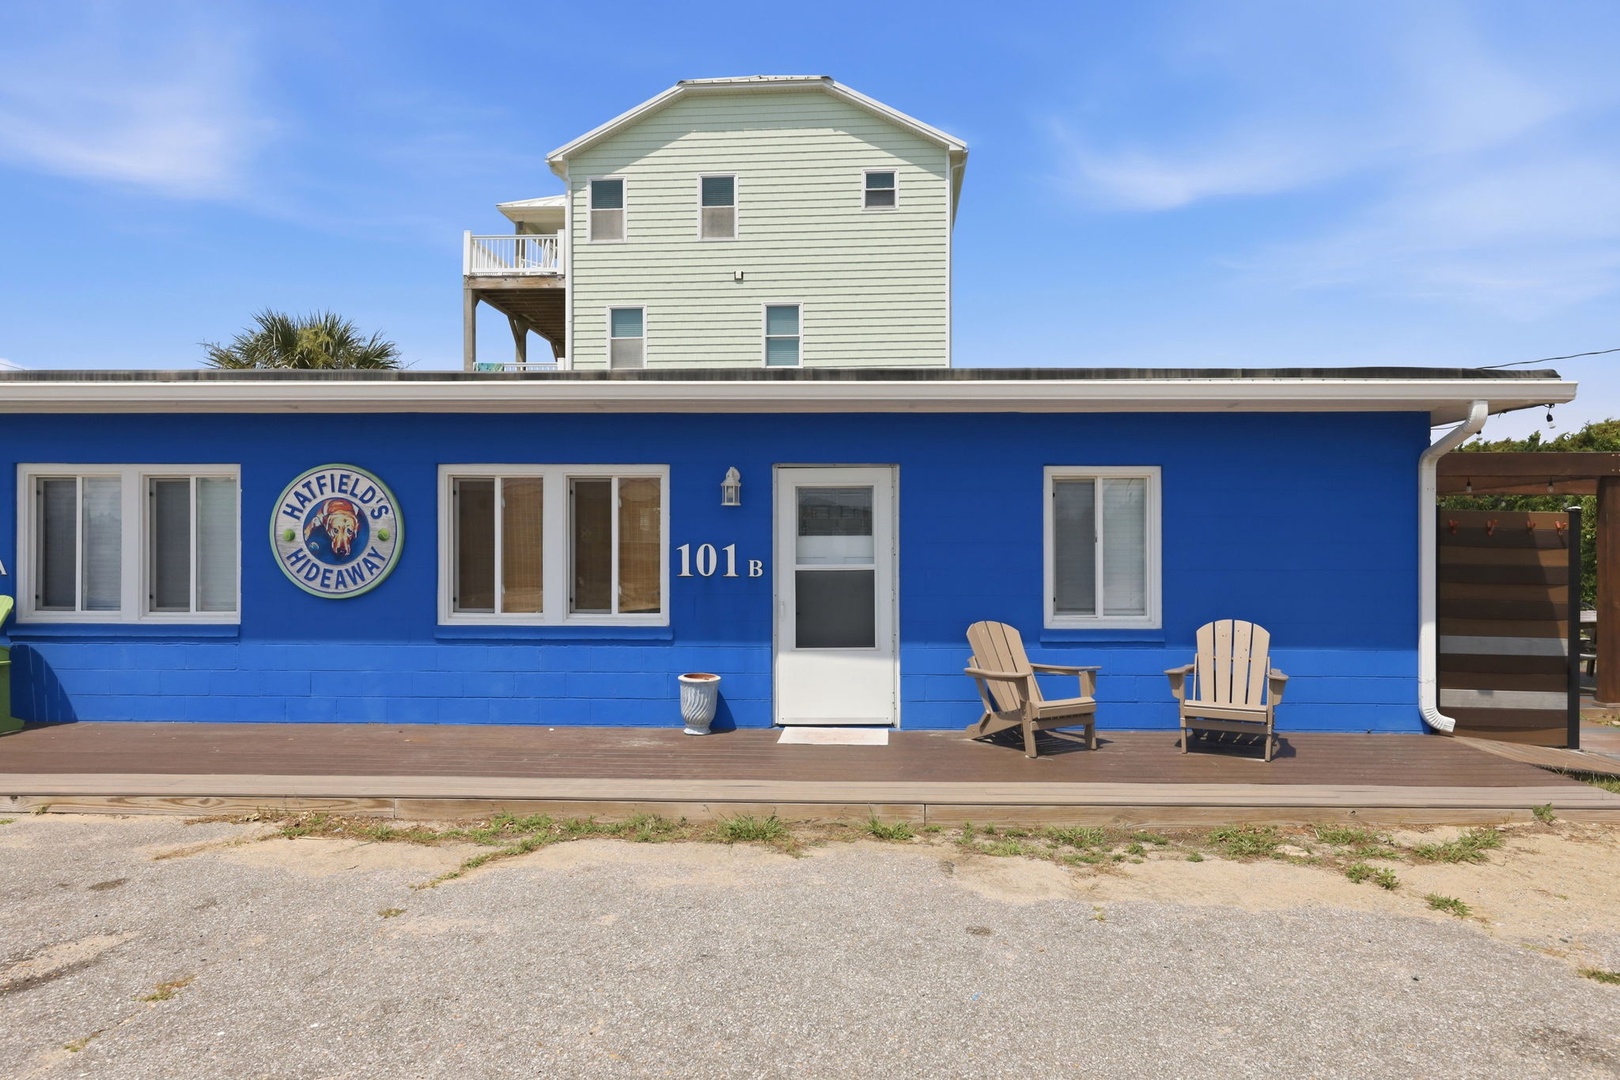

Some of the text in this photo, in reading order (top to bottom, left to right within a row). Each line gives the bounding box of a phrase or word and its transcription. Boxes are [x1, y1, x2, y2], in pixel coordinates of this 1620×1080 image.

[282, 473, 389, 520] HATFIELD'S
[286, 546, 386, 589] HIDEAWAY
[676, 543, 763, 577] 101 B
